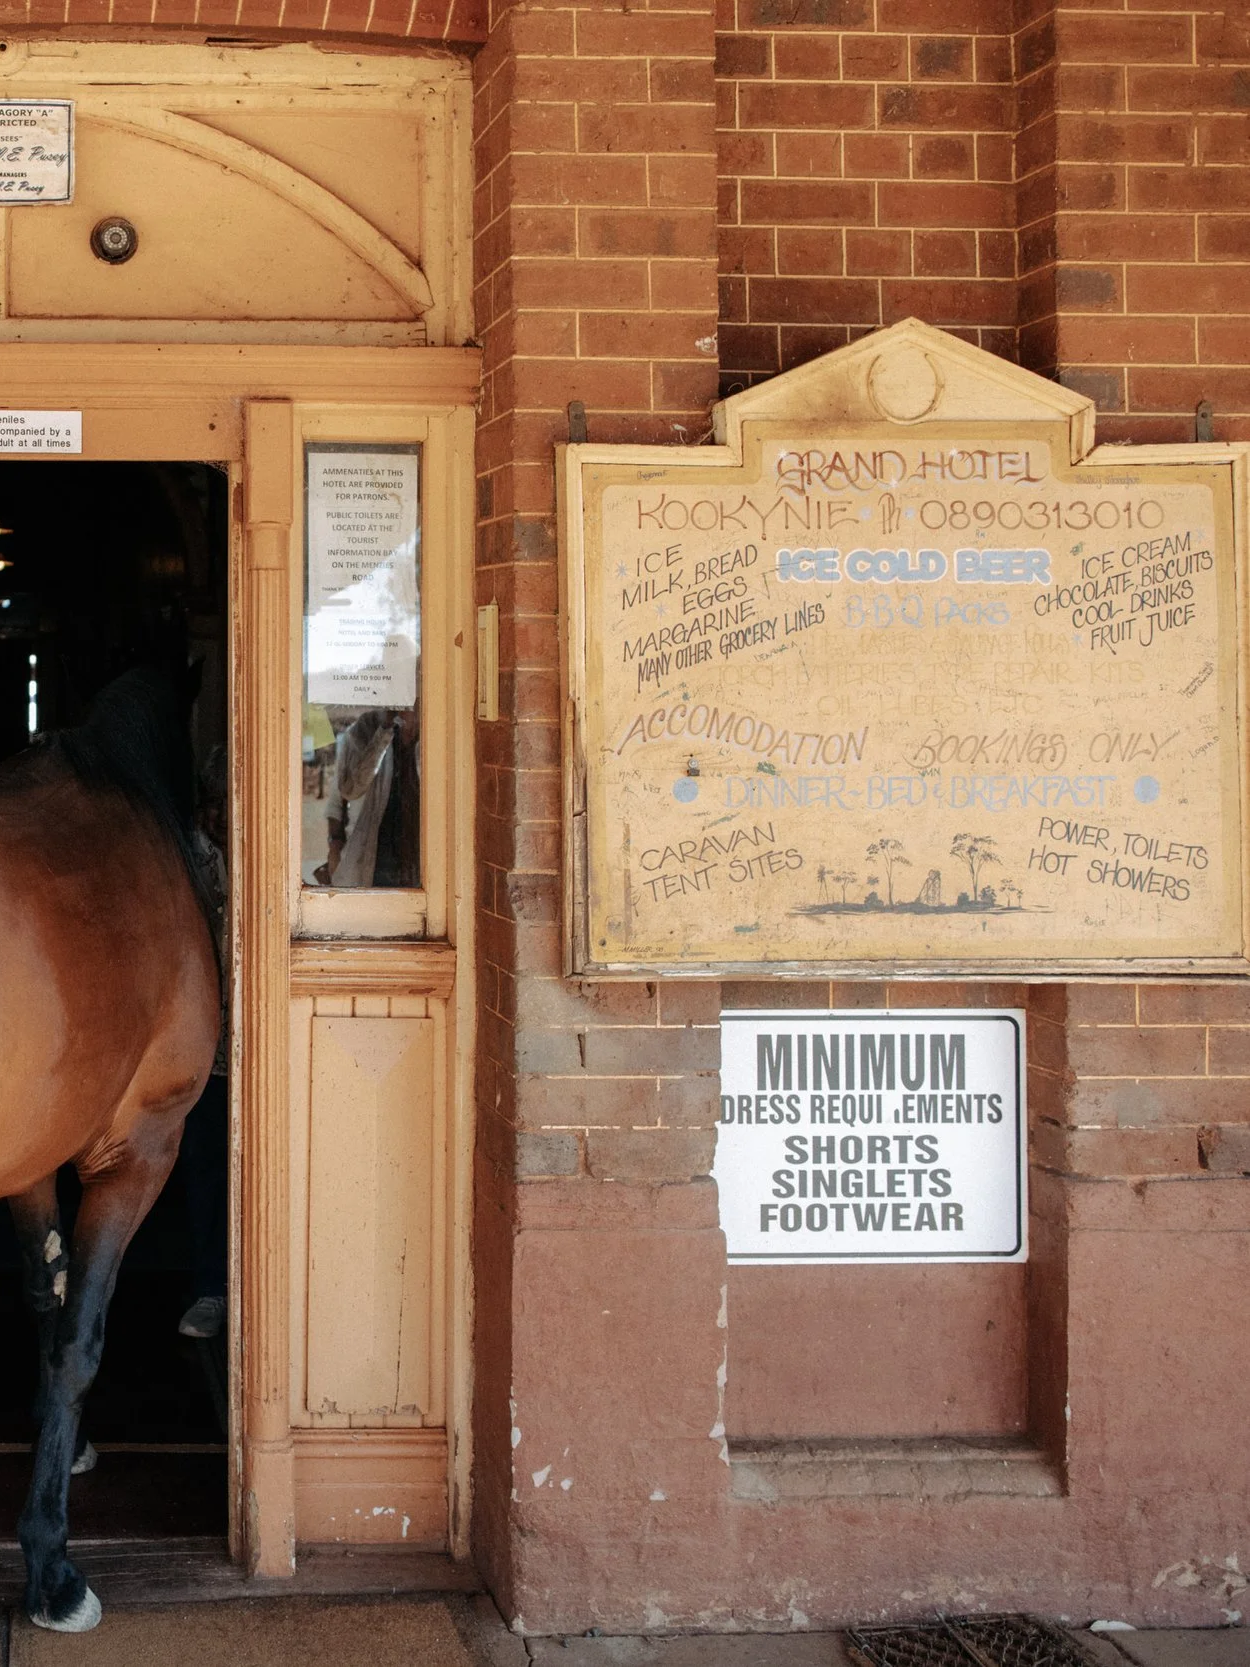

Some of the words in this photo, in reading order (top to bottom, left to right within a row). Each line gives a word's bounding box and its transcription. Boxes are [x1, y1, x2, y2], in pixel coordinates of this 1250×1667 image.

[50, 428, 60, 437] by
[323, 468, 374, 476] AMMENATIES
[387, 469, 403, 477] THIS
[365, 481, 403, 489] PROVIDED
[775, 451, 908, 496] GRAND
[907, 450, 1046, 485] HOTEL
[336, 493, 351, 501] FOR
[332, 524, 365, 532] LOCATED
[367, 524, 377, 532] AT
[379, 524, 393, 532] THE
[638, 494, 859, 540] KOOKYNIE
[920, 500, 1165, 530] 0890313010
[328, 549, 381, 557] INFORMATION
[383, 549, 398, 557] BAY
[347, 536, 378, 544] TOURIST
[1081, 551, 1115, 579] ICE
[1121, 532, 1192, 569] CREAM
[332, 561, 344, 569] ON
[346, 561, 360, 569] THE
[352, 573, 374, 581] ROAD
[636, 544, 682, 576] ICE
[694, 545, 758, 585] BREAD
[776, 548, 842, 582] ICE
[845, 548, 947, 582] COLD
[954, 549, 1052, 585] BEER
[1141, 550, 1213, 589] BISCUITS
[683, 576, 747, 615] EGGS
[1072, 600, 1123, 629] COOL
[1130, 579, 1193, 614] DRINKS
[623, 599, 755, 662] MARGARINE
[638, 650, 671, 694] MANY
[675, 639, 712, 670] OTHER
[720, 618, 778, 658] GROCERY
[785, 601, 825, 635] LINES
[1091, 618, 1137, 655] FRUIT
[1139, 604, 1196, 647] JUICE
[617, 704, 869, 765] ACCOMODATION
[902, 728, 1067, 771] BOOKINGS
[1089, 729, 1181, 763] ONLY
[950, 774, 1118, 812] BREAKFAST
[640, 822, 776, 871] CARAVAN
[1123, 833, 1209, 870] TOILETS
[643, 863, 718, 902] TENT
[728, 849, 803, 883] SITES
[1028, 845, 1078, 876] HOT
[1087, 859, 1191, 901] SHOWERS
[756, 1034, 966, 1091] MINIMUM
[721, 1094, 801, 1124] DRESS
[810, 1093, 1003, 1127] REQUIEMENTS
[784, 1135, 939, 1164] SHORTS
[772, 1168, 952, 1198] SINGLETS
[760, 1202, 964, 1232] FOOTWEAR
